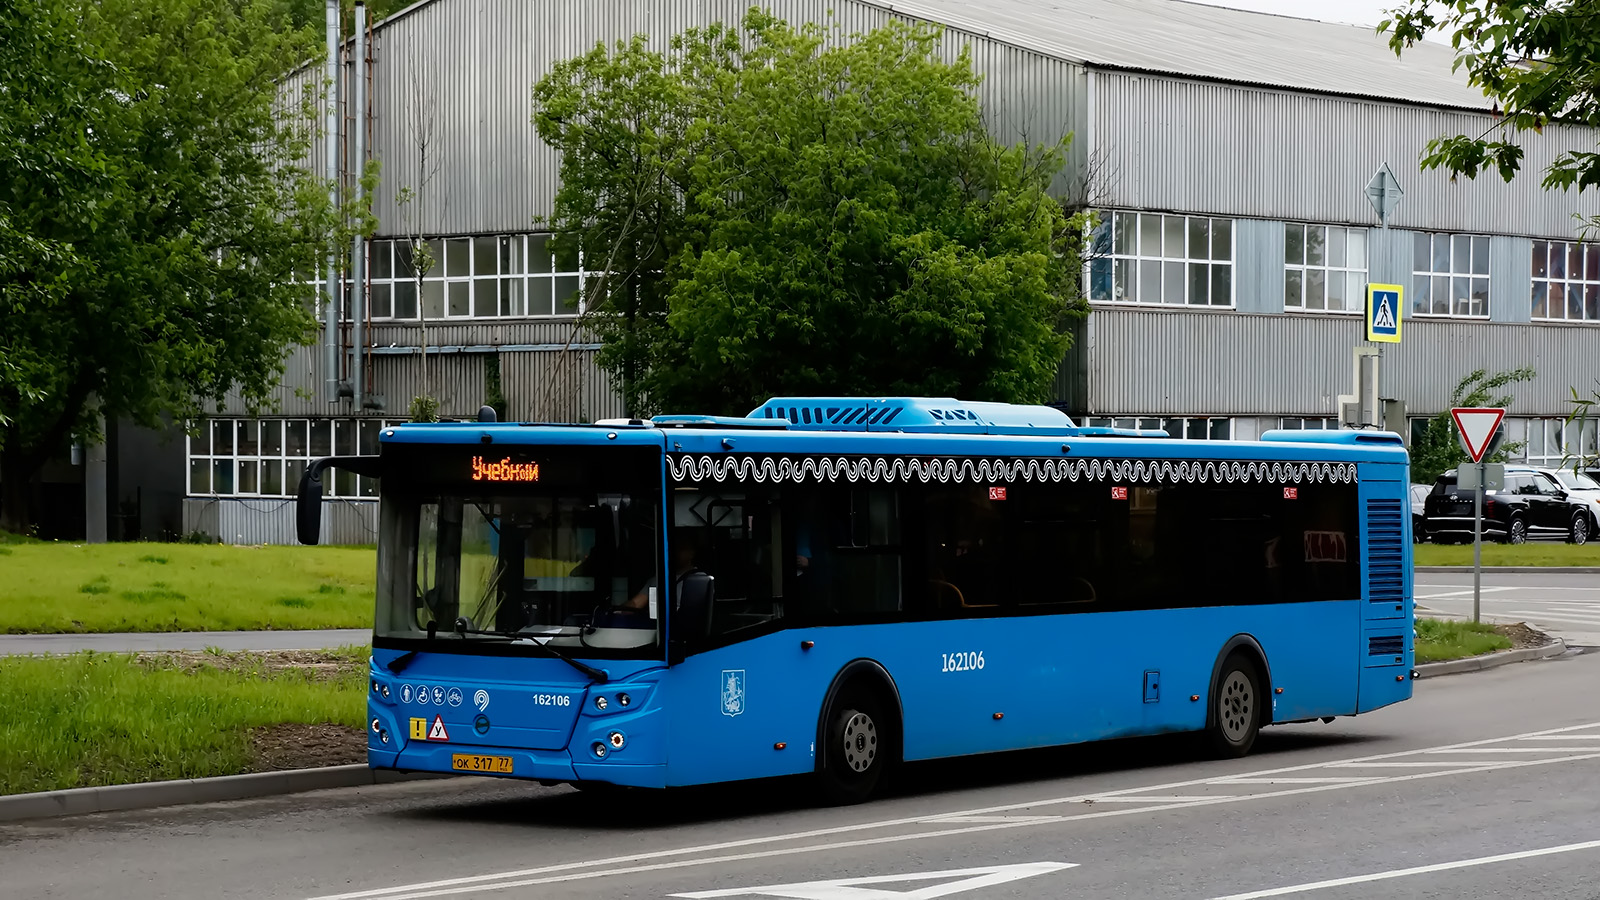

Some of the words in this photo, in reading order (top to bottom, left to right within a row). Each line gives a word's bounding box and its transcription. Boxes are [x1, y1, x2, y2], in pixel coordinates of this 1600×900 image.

[472, 456, 539, 481] Учебный
[942, 651, 985, 672] 162106
[532, 694, 570, 707] 162106
[473, 756, 493, 770] 317
[498, 757, 509, 768] 77
